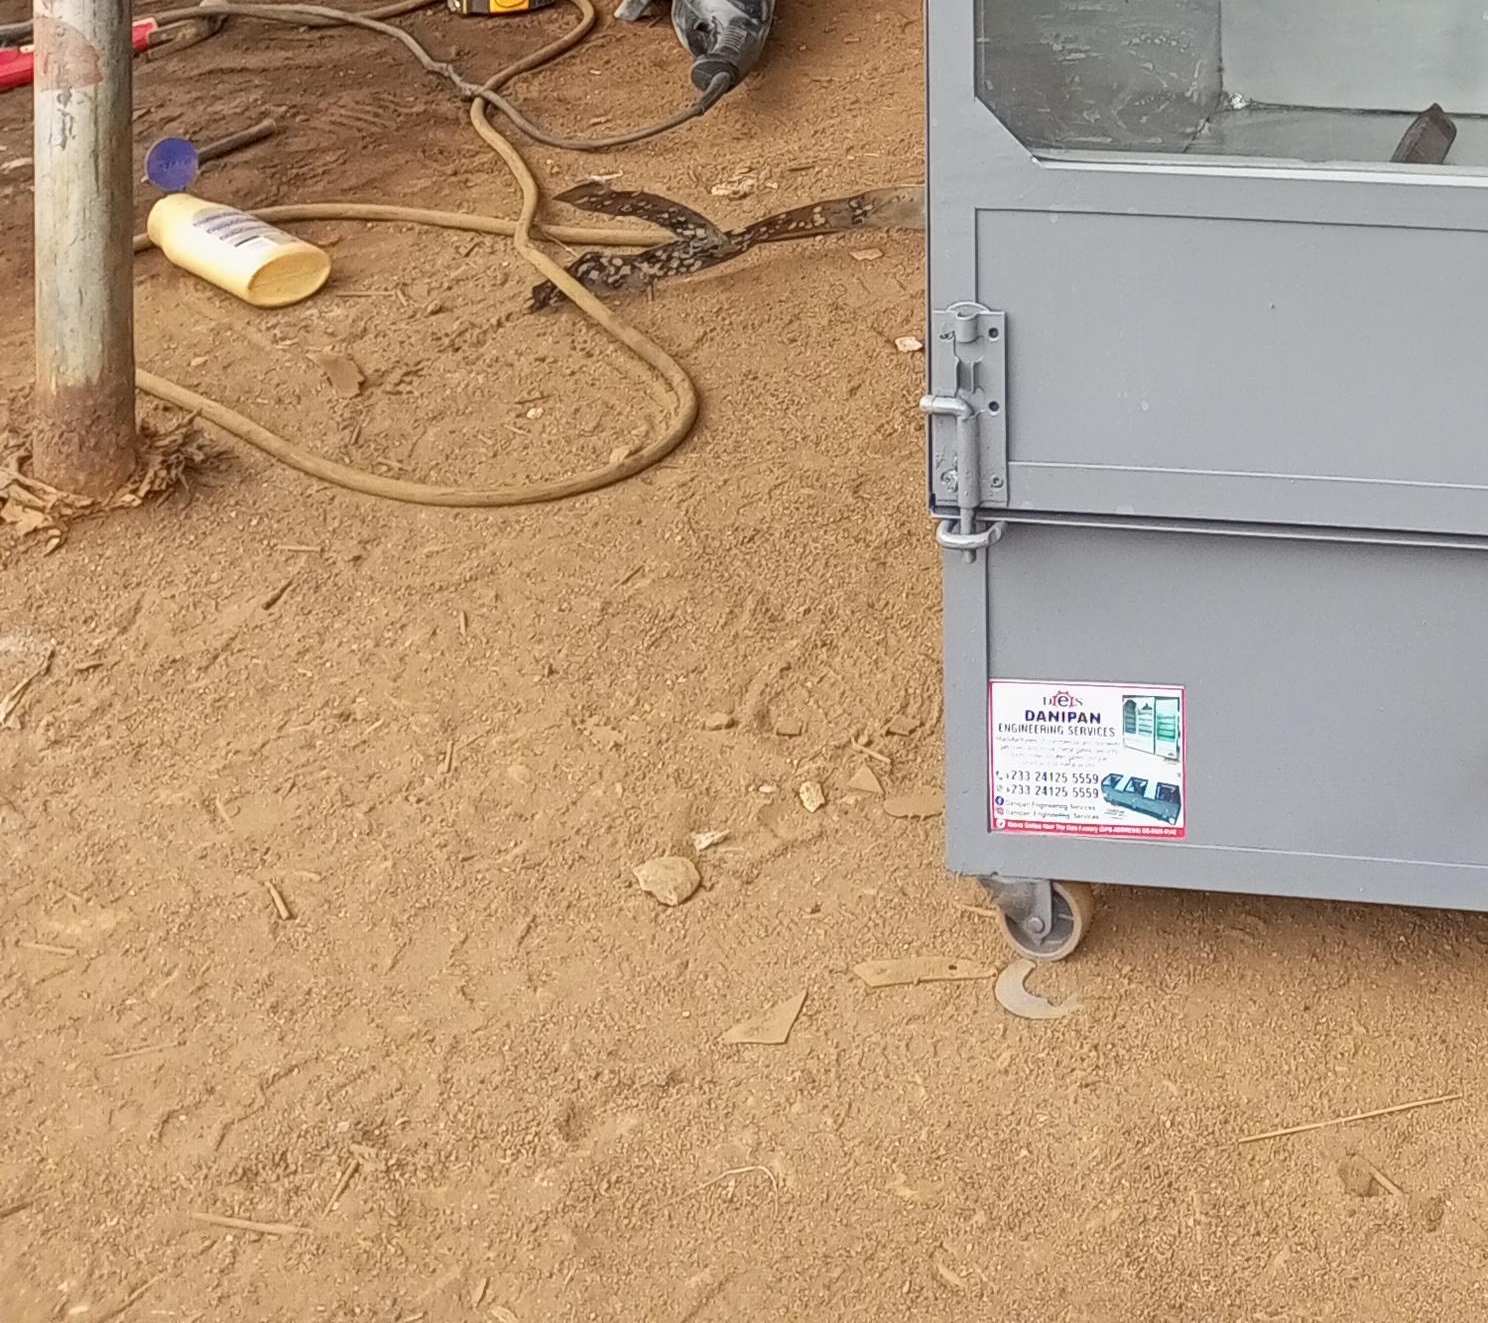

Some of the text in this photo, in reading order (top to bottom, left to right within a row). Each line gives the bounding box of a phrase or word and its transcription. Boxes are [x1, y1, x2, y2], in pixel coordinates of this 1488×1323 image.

[1024, 709, 1101, 724] DANIPAN
[998, 722, 1115, 737] ENGINEERING SERVICES
[1034, 771, 1068, 783] 24125
[1072, 773, 1099, 785] 5559
[1034, 785, 1068, 797] 24125
[1072, 787, 1099, 799] 5559
